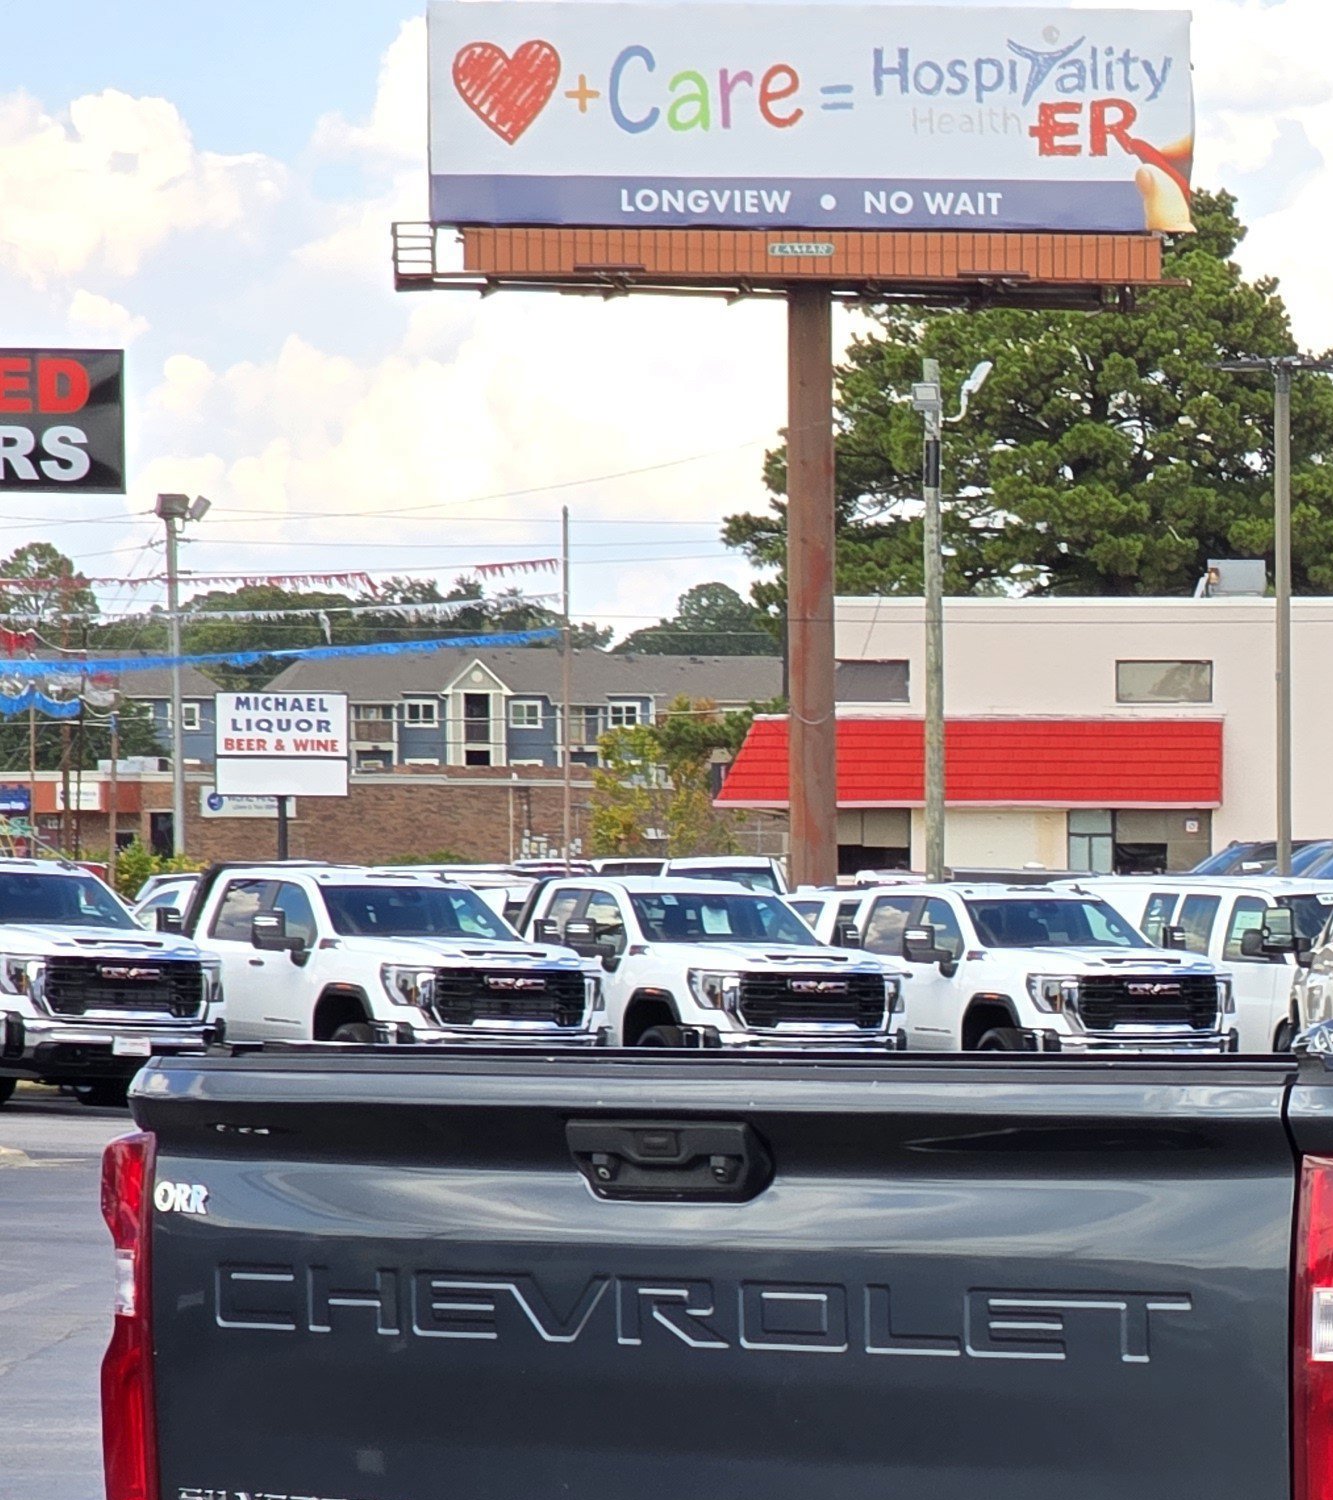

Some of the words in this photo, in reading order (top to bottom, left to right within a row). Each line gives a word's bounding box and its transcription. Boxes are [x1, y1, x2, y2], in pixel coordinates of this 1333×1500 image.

[608, 45, 804, 134] Care
[911, 107, 1022, 135] Health
[1029, 98, 1137, 157] ER
[620, 189, 791, 214] LONGVIEW
[864, 191, 913, 215] NO
[923, 192, 1003, 217] WAIT
[0, 356, 90, 414] ED
[0, 425, 91, 481] RS
[231, 718, 331, 733] LIQUOR
[235, 696, 329, 712] MICHAEL
[224, 738, 267, 752] BEER
[274, 739, 285, 751] &
[293, 739, 339, 752] WINE
[153, 1181, 208, 1215] ORR
[215, 1260, 1192, 1363] CHEVROLET
